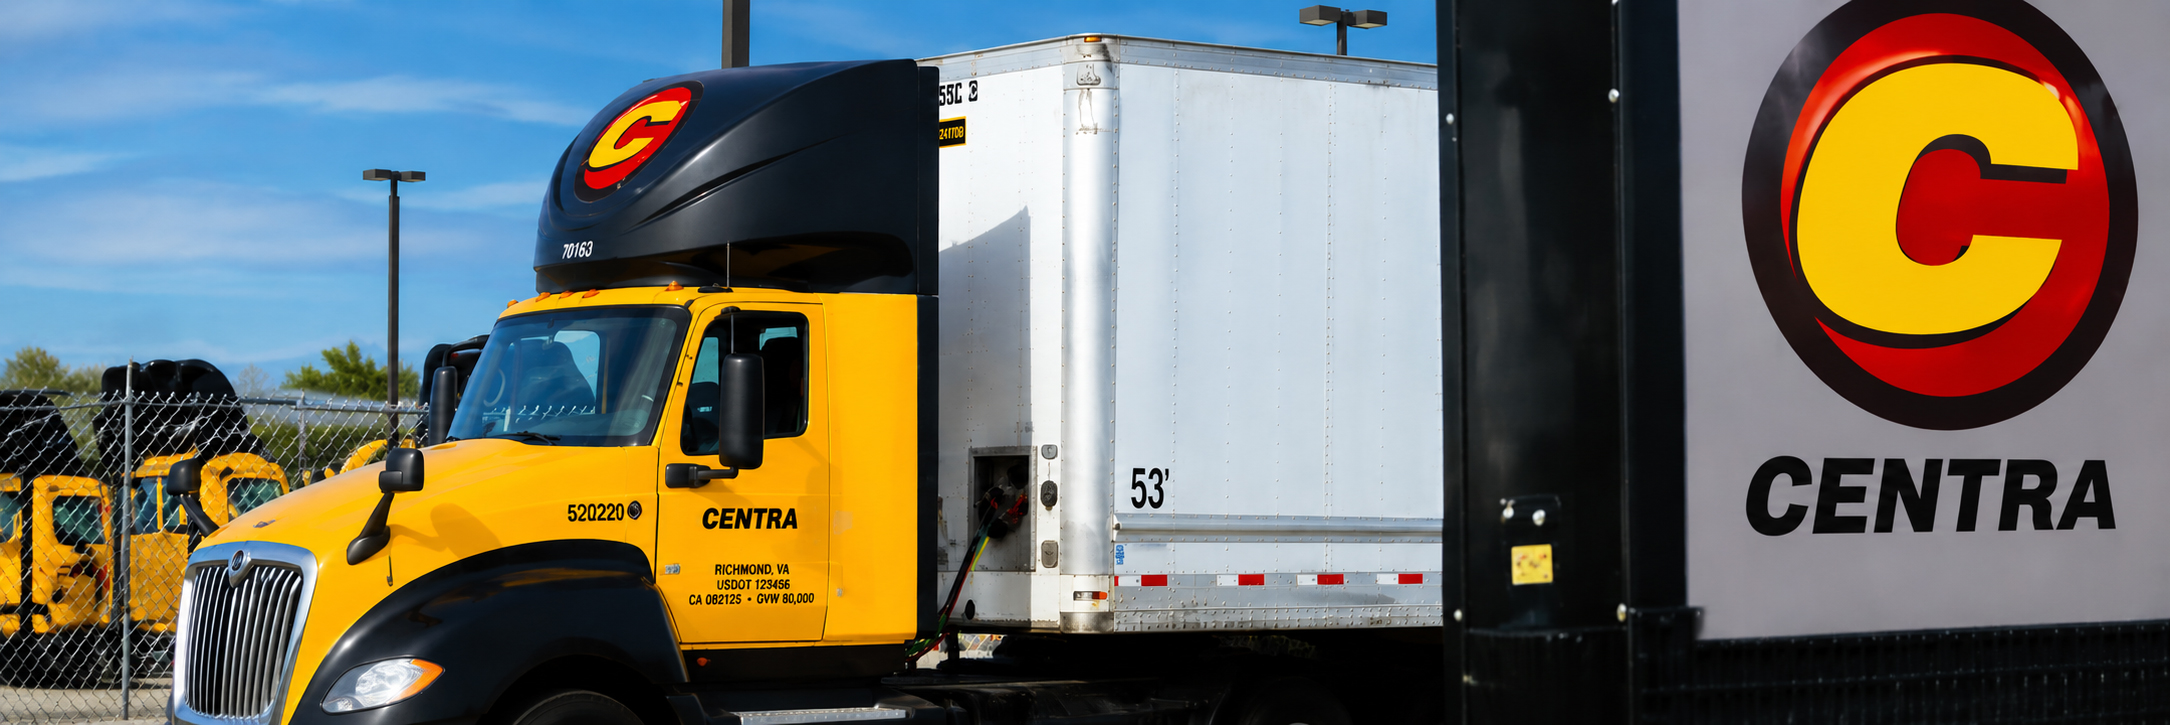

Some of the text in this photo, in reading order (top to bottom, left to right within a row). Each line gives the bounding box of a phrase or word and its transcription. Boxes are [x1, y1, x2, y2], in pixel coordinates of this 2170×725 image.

[588, 100, 682, 168] C
[1797, 63, 2079, 335] C
[562, 240, 594, 260] 70163
[1745, 456, 2117, 536] CENTRA
[567, 503, 625, 522] 520220
[702, 508, 798, 530] CENTRA
[715, 563, 790, 576] RICHMOND, VA
[717, 579, 791, 591] USDOT 123456
[689, 594, 703, 605] CA
[756, 593, 780, 604] GVW
[782, 592, 815, 605] 80,000
